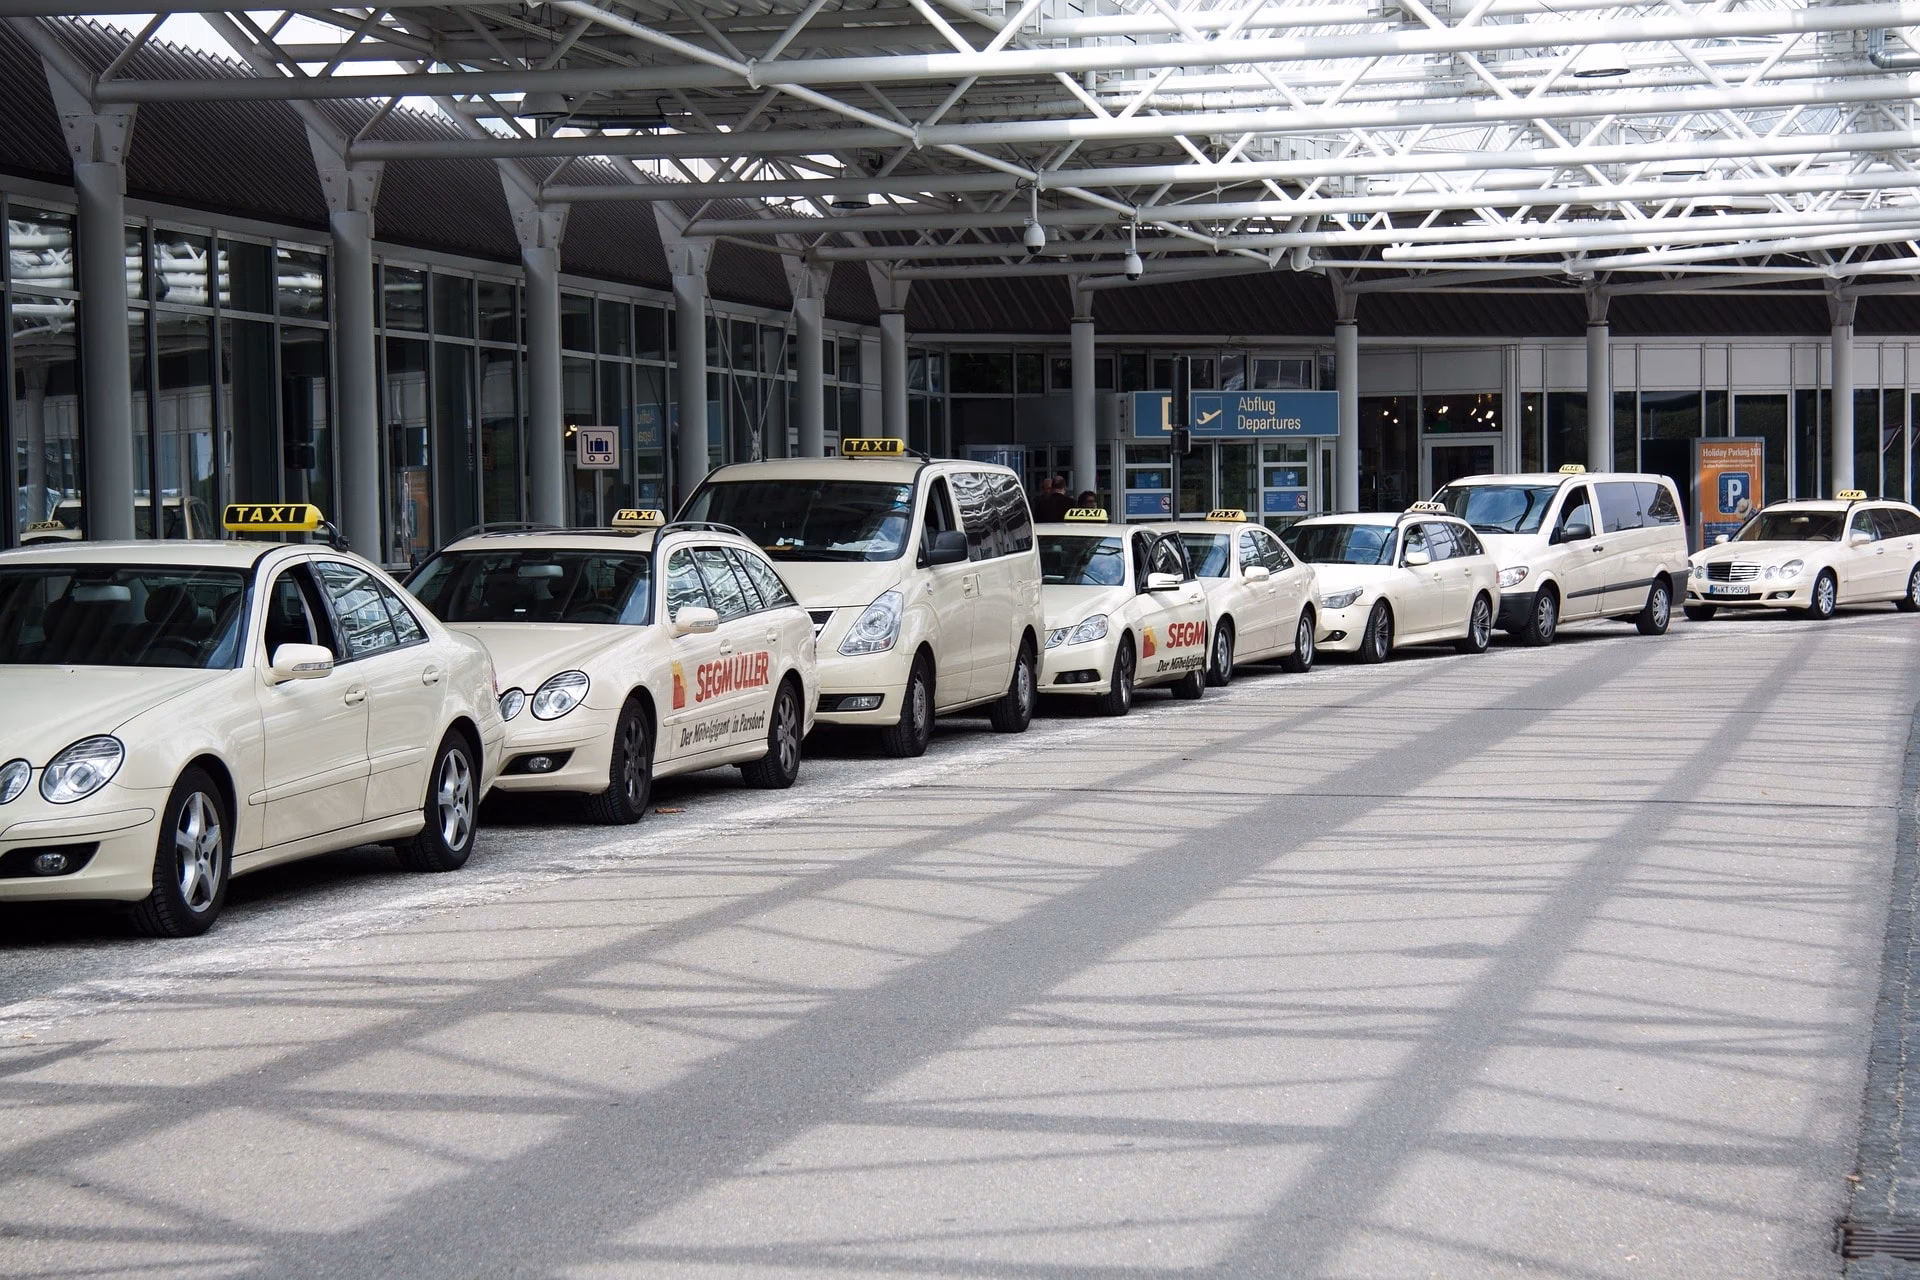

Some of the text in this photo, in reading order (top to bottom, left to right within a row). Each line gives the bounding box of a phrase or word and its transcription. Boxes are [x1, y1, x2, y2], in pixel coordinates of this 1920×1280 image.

[1238, 397, 1276, 415] Abflug
[1237, 415, 1301, 433] Departures
[851, 440, 891, 452] TAXI
[1703, 448, 1727, 458] Holiday
[1728, 448, 1750, 458] Parking
[1727, 479, 1742, 507] P
[1071, 509, 1101, 517] TAXI
[1416, 503, 1441, 511] TAXI
[236, 507, 297, 522] TAXI
[620, 511, 656, 520] TAXI
[1166, 621, 1204, 648] SEGM
[1157, 659, 1170, 672] Der
[680, 710, 765, 747] Der Möbelgigant in Parsdorf
